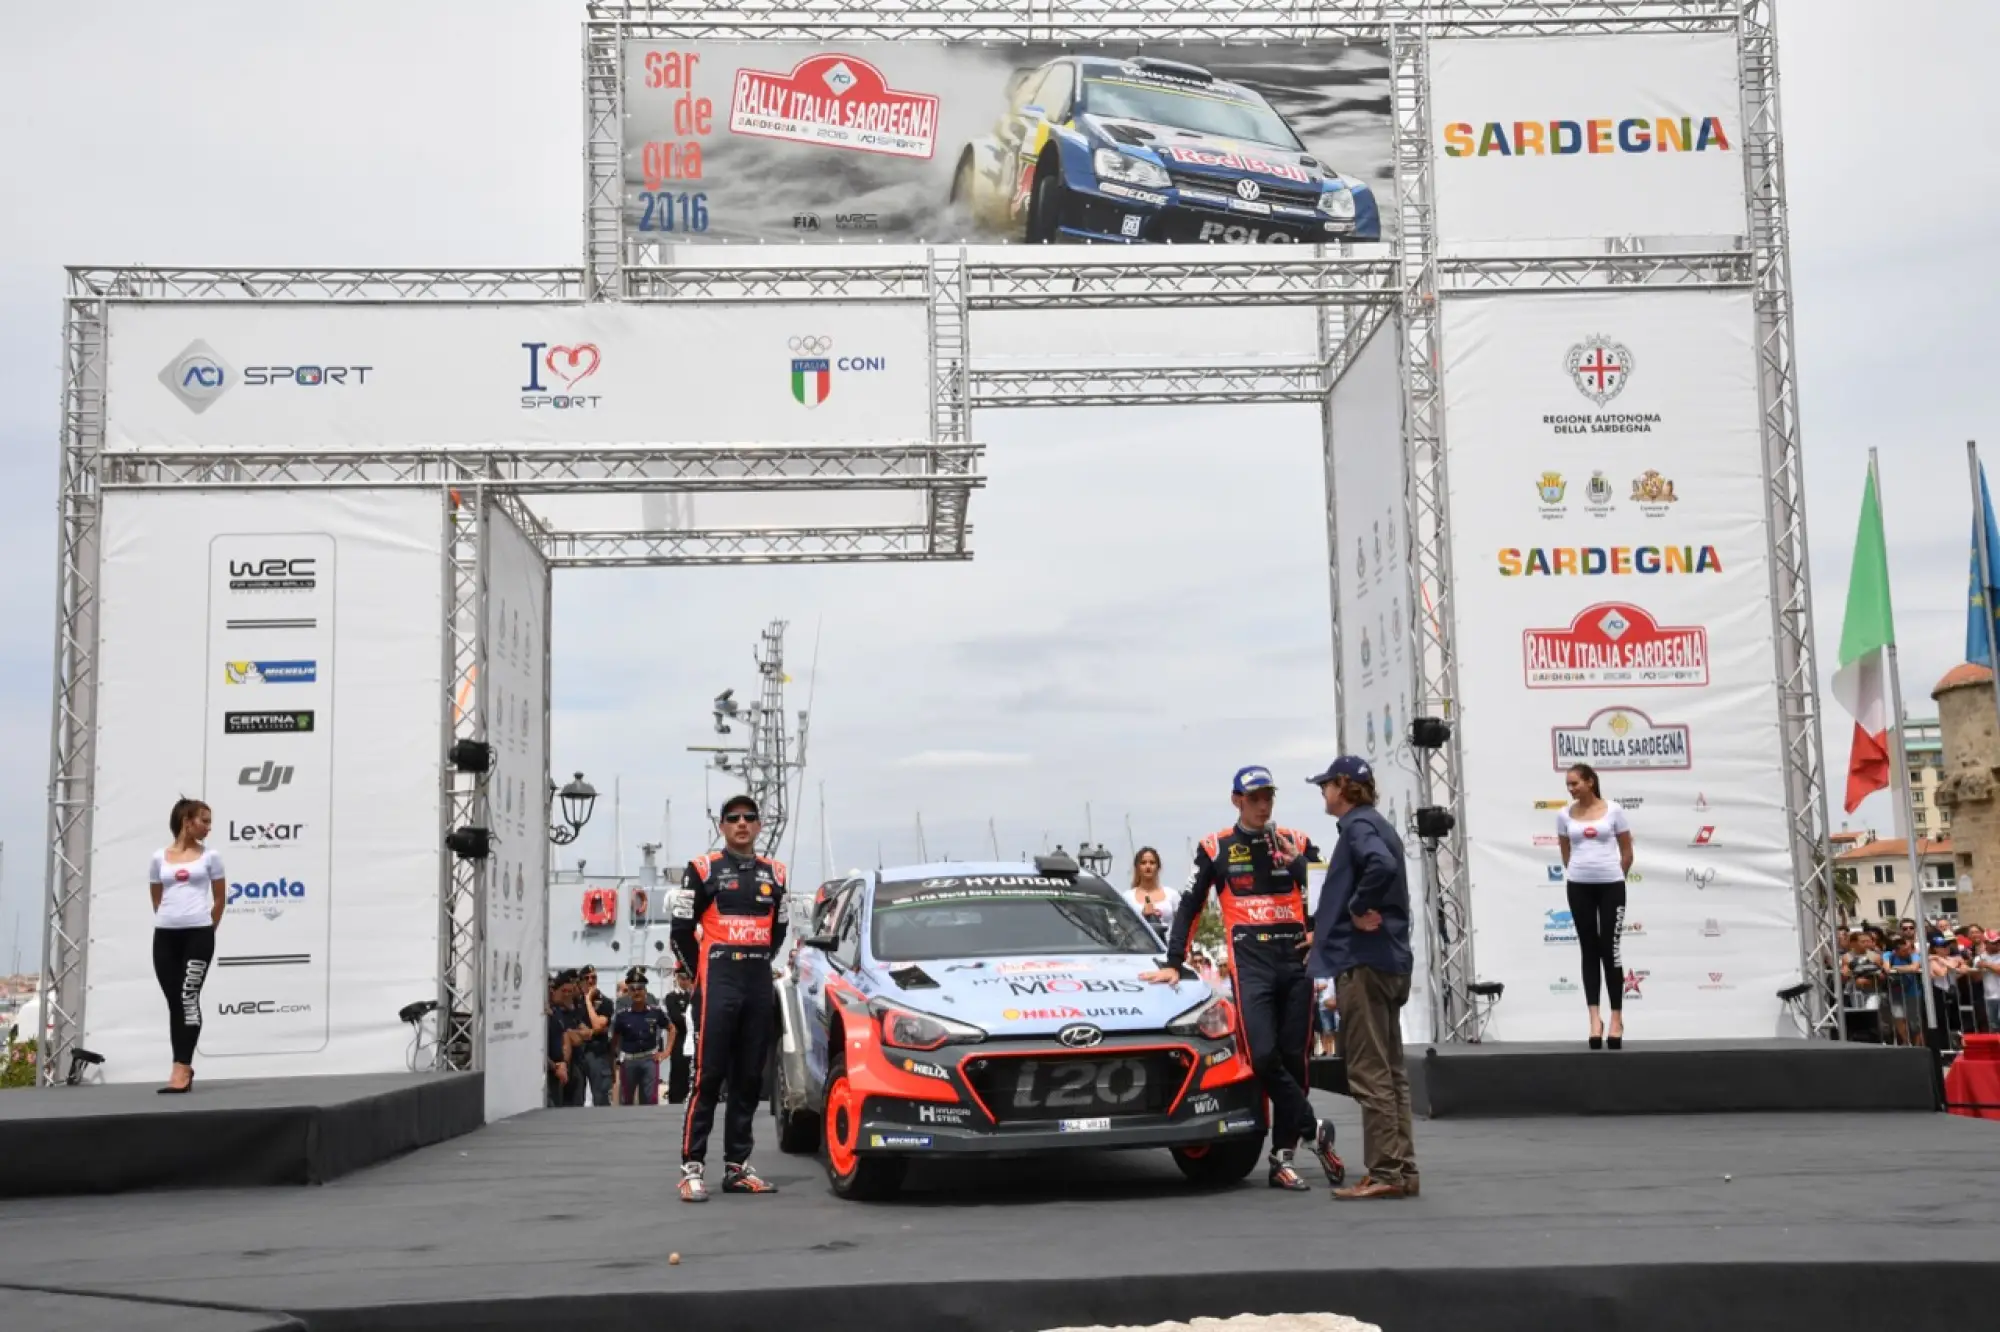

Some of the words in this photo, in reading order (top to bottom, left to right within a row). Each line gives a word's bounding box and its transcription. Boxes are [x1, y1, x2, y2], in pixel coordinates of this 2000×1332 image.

[644, 50, 700, 89] sar
[832, 73, 851, 85] ACI
[674, 91, 712, 136] de
[736, 73, 788, 118] RALLY
[788, 91, 840, 126] ITALIA
[844, 100, 933, 138] SARDEGNA
[1444, 116, 1730, 158] SARDEGNA
[642, 141, 702, 191] gna
[638, 191, 709, 232] 2016
[793, 215, 818, 229] FIA
[521, 342, 548, 392] I
[792, 360, 829, 372] ITALIA
[837, 356, 885, 372] CONI
[182, 366, 225, 388] ACI
[243, 365, 374, 386] SPORT
[521, 394, 603, 410] SPORT
[1543, 414, 1592, 424] REGIONE
[1595, 413, 1662, 424] AUTONOMA
[1554, 424, 1587, 434] DELLA
[1590, 424, 1652, 434] SARDEGNA
[229, 559, 316, 577] WRC
[1498, 545, 1723, 576] SARDEGNA
[1528, 632, 1571, 669] RALLY
[1575, 641, 1621, 669] ITALIA
[1624, 631, 1703, 668] SARDEGNA
[265, 667, 316, 675] MICHELIN
[229, 714, 295, 725] CERTINA
[1557, 732, 1590, 757] RALLY
[1592, 739, 1626, 757] DELLA
[1627, 730, 1685, 757] SARDEGNA
[238, 760, 295, 793] dji
[229, 820, 304, 842] Lexar
[965, 876, 1072, 887] HYUNDAI
[226, 877, 306, 905] panta
[1249, 905, 1296, 921] MOBIS
[972, 973, 1074, 986] HYUNDAI
[1009, 979, 1145, 997] MOBIS
[219, 1000, 311, 1016] WRC.com
[1021, 1005, 1087, 1020] HELIX
[1086, 1006, 1143, 1018] ULTRA
[913, 1063, 951, 1080] HELIX
[936, 1115, 962, 1124] STEEL
[886, 1137, 929, 1145] MICHELIN
